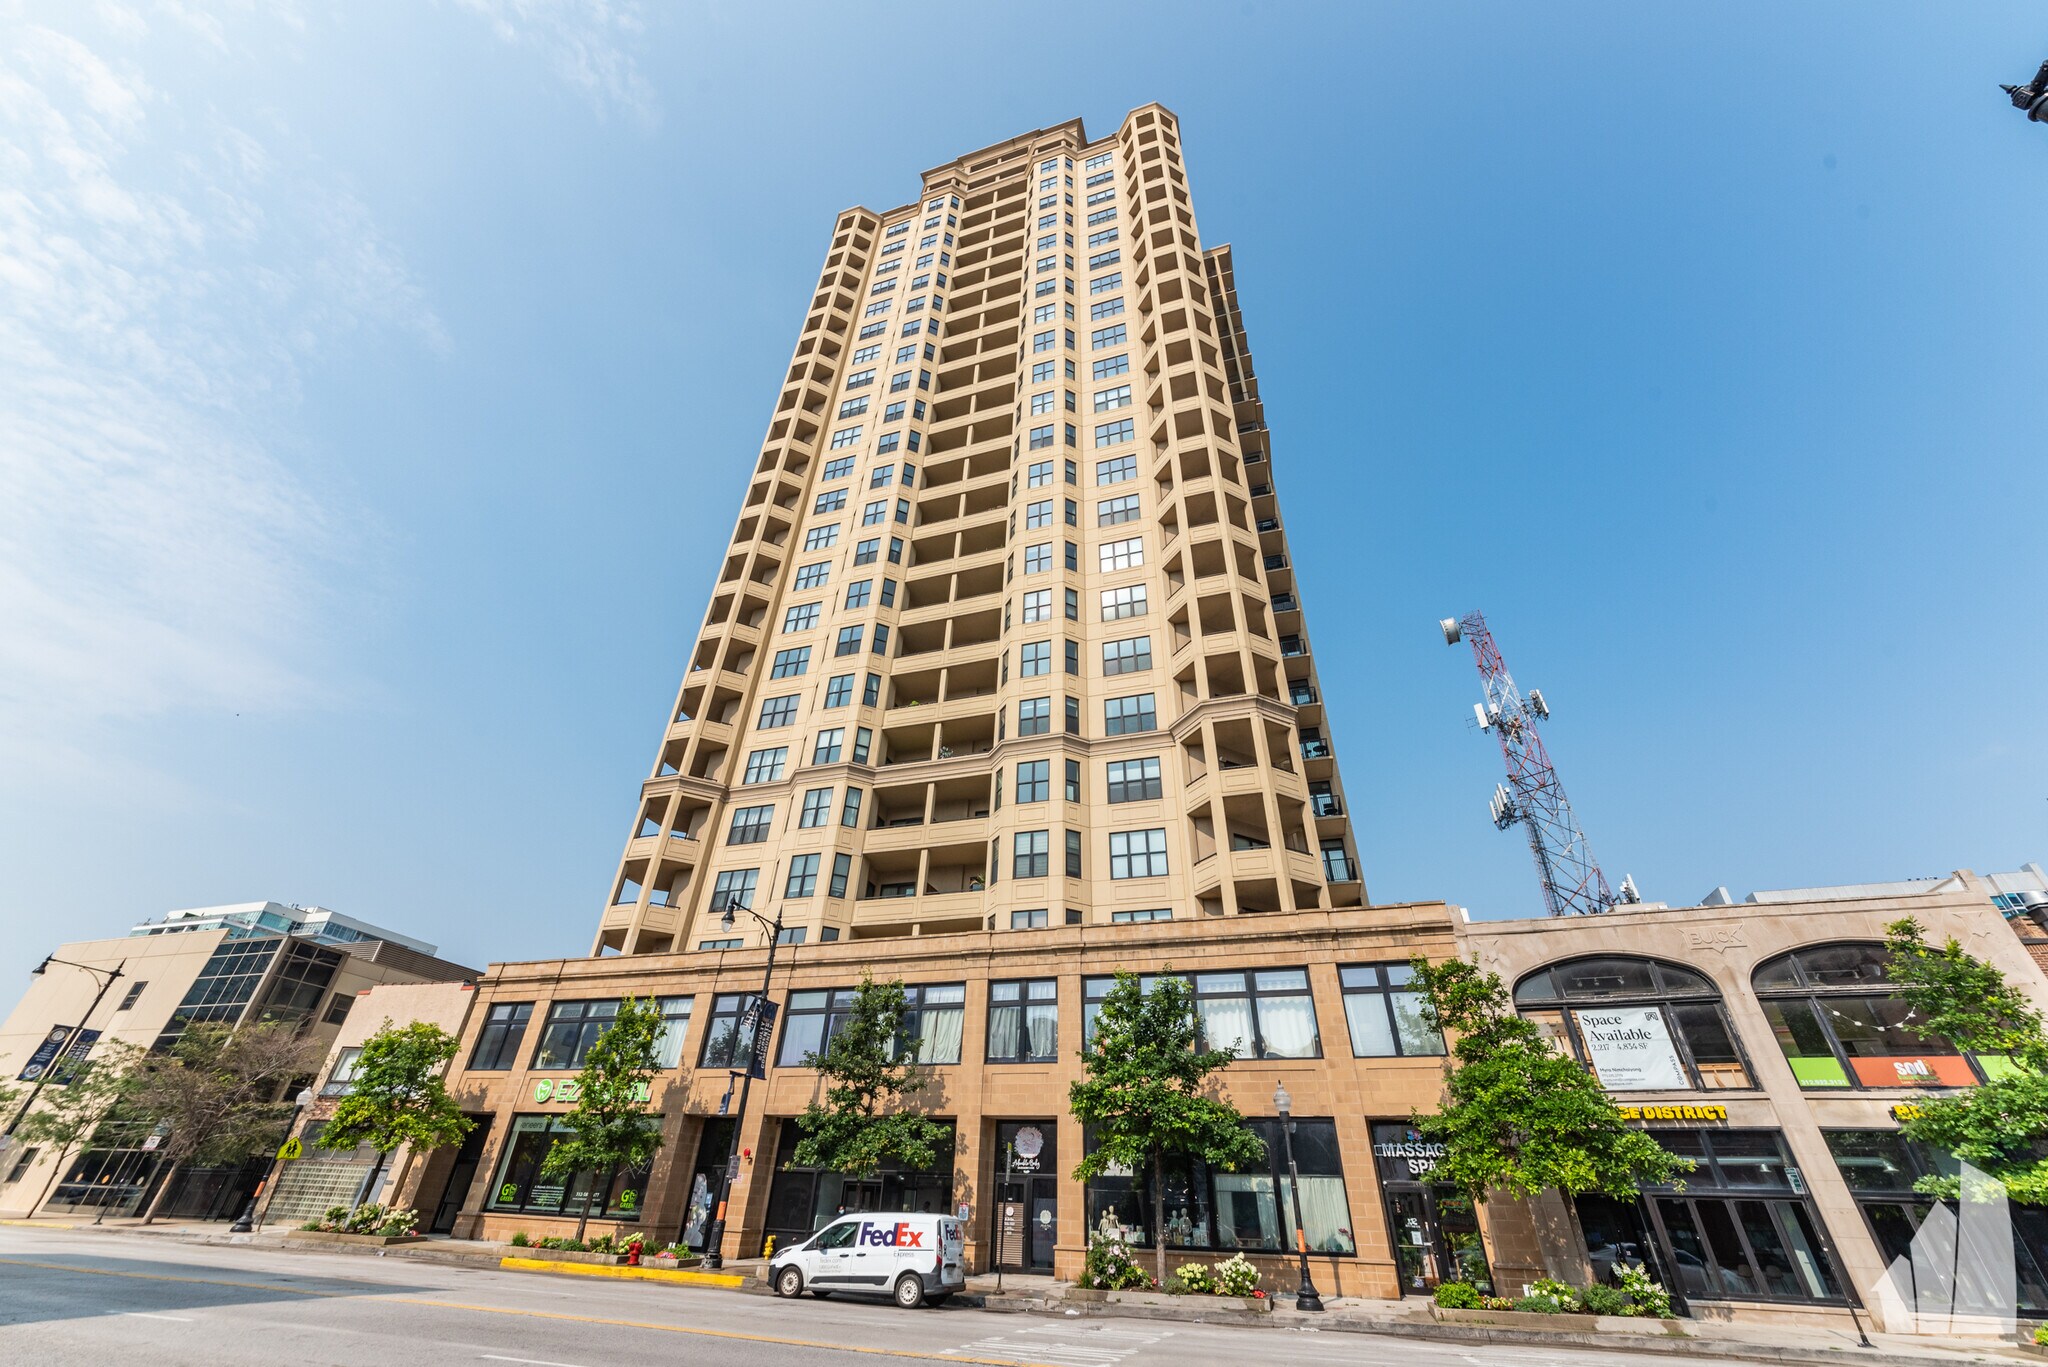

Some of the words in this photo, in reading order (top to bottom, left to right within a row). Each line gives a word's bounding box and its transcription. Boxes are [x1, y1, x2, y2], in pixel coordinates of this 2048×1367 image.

[1689, 929, 1742, 945] BUICK
[1582, 1014, 1622, 1028] Space
[1590, 1028, 1652, 1042] Available
[1669, 1055, 1684, 1086] COMPASS
[1893, 1060, 1930, 1076] sod
[554, 1079, 581, 1102] EZ
[1642, 1105, 1727, 1120] DISTRICT
[1381, 1142, 1449, 1158] MASSAG
[860, 1222, 924, 1247] FedEx
